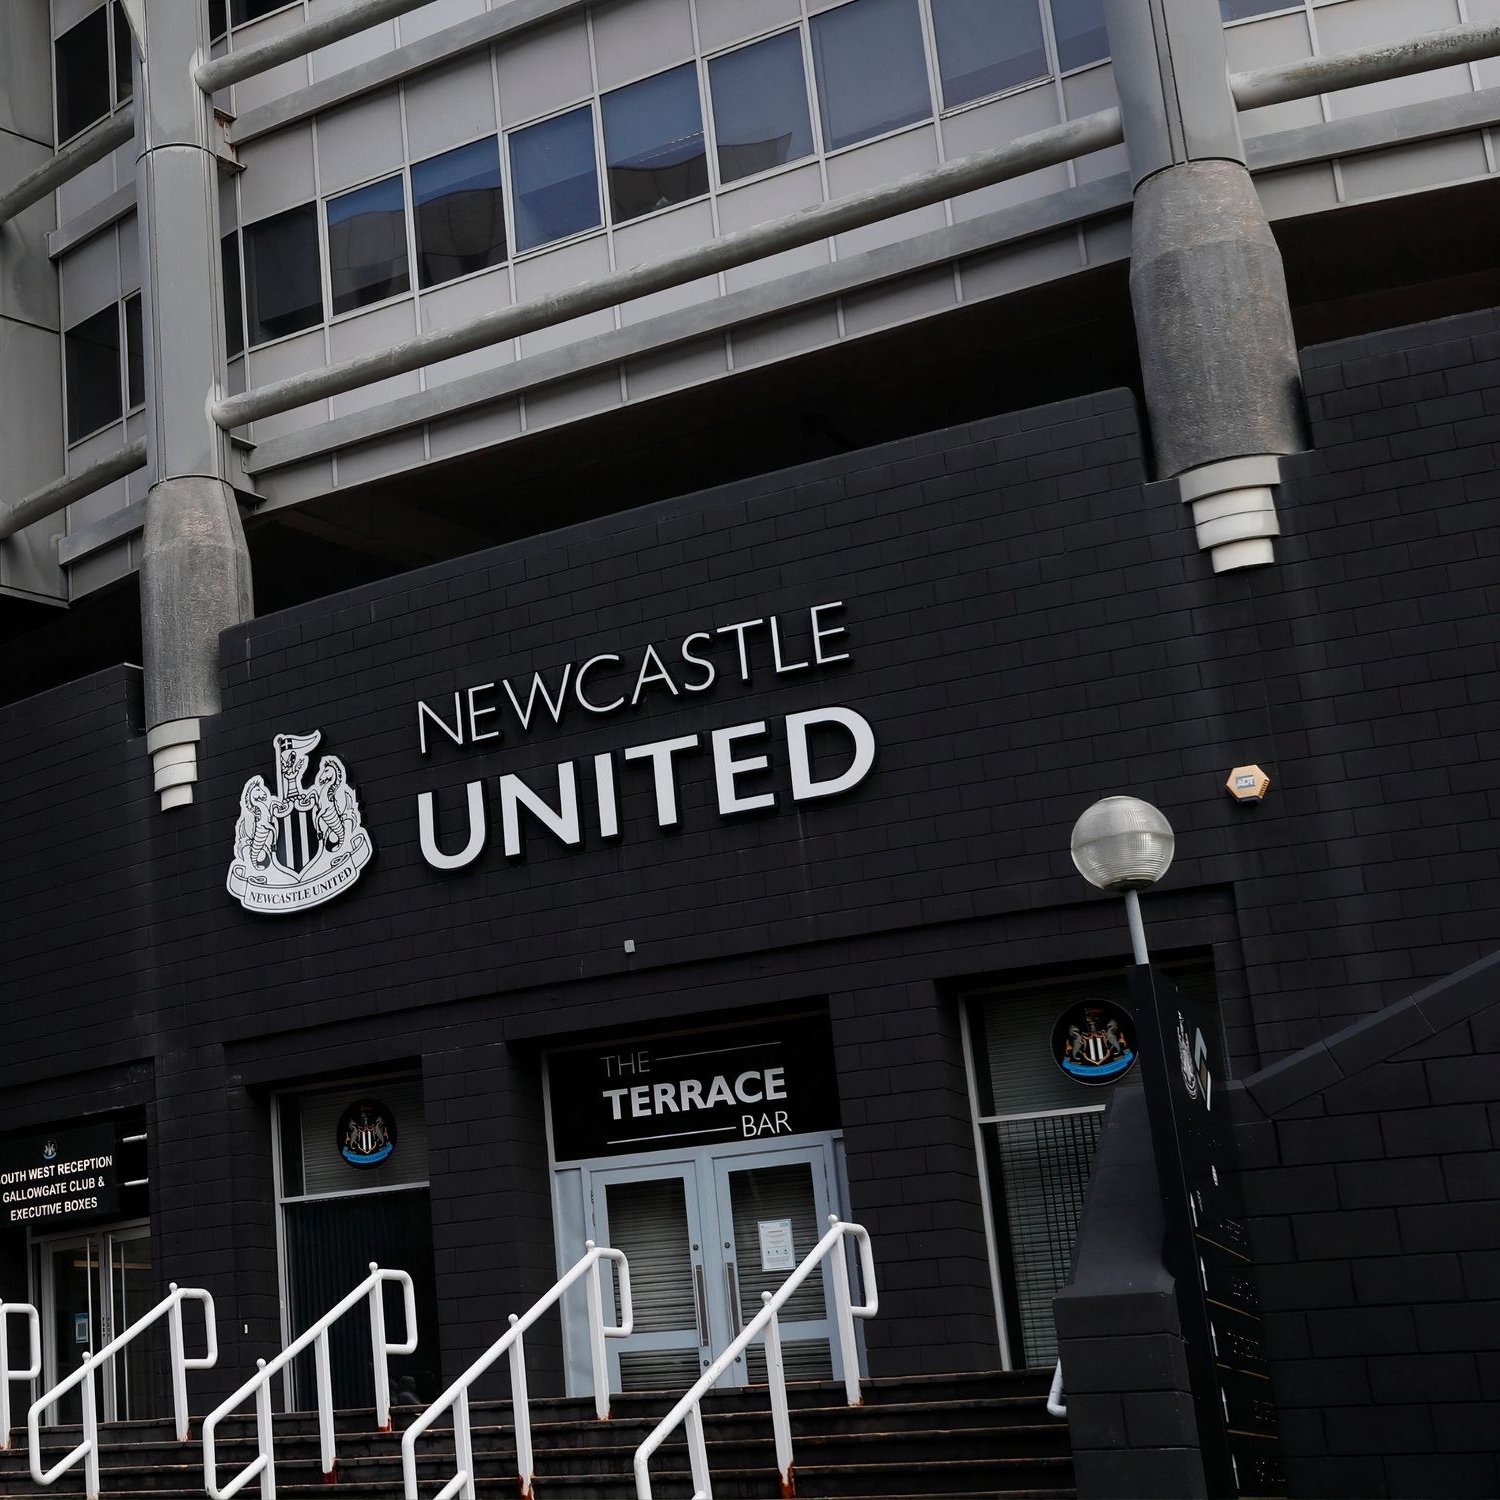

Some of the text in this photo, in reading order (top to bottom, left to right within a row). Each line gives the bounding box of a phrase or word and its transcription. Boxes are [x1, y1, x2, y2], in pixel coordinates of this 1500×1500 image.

[417, 601, 850, 754] NEWCASTLE
[417, 706, 876, 870] UNITED
[250, 867, 352, 905] NEWCASTLE UNITED
[600, 1050, 651, 1078] THE
[602, 1067, 788, 1120] TERRACE
[741, 1110, 793, 1138] BAR
[28, 1165, 56, 1181] WEST
[57, 1155, 113, 1176] RECEPTION
[2, 1175, 105, 1203] GALLOWGATE CLUB &
[10, 1196, 98, 1221] EXECUTIVE BOXES
